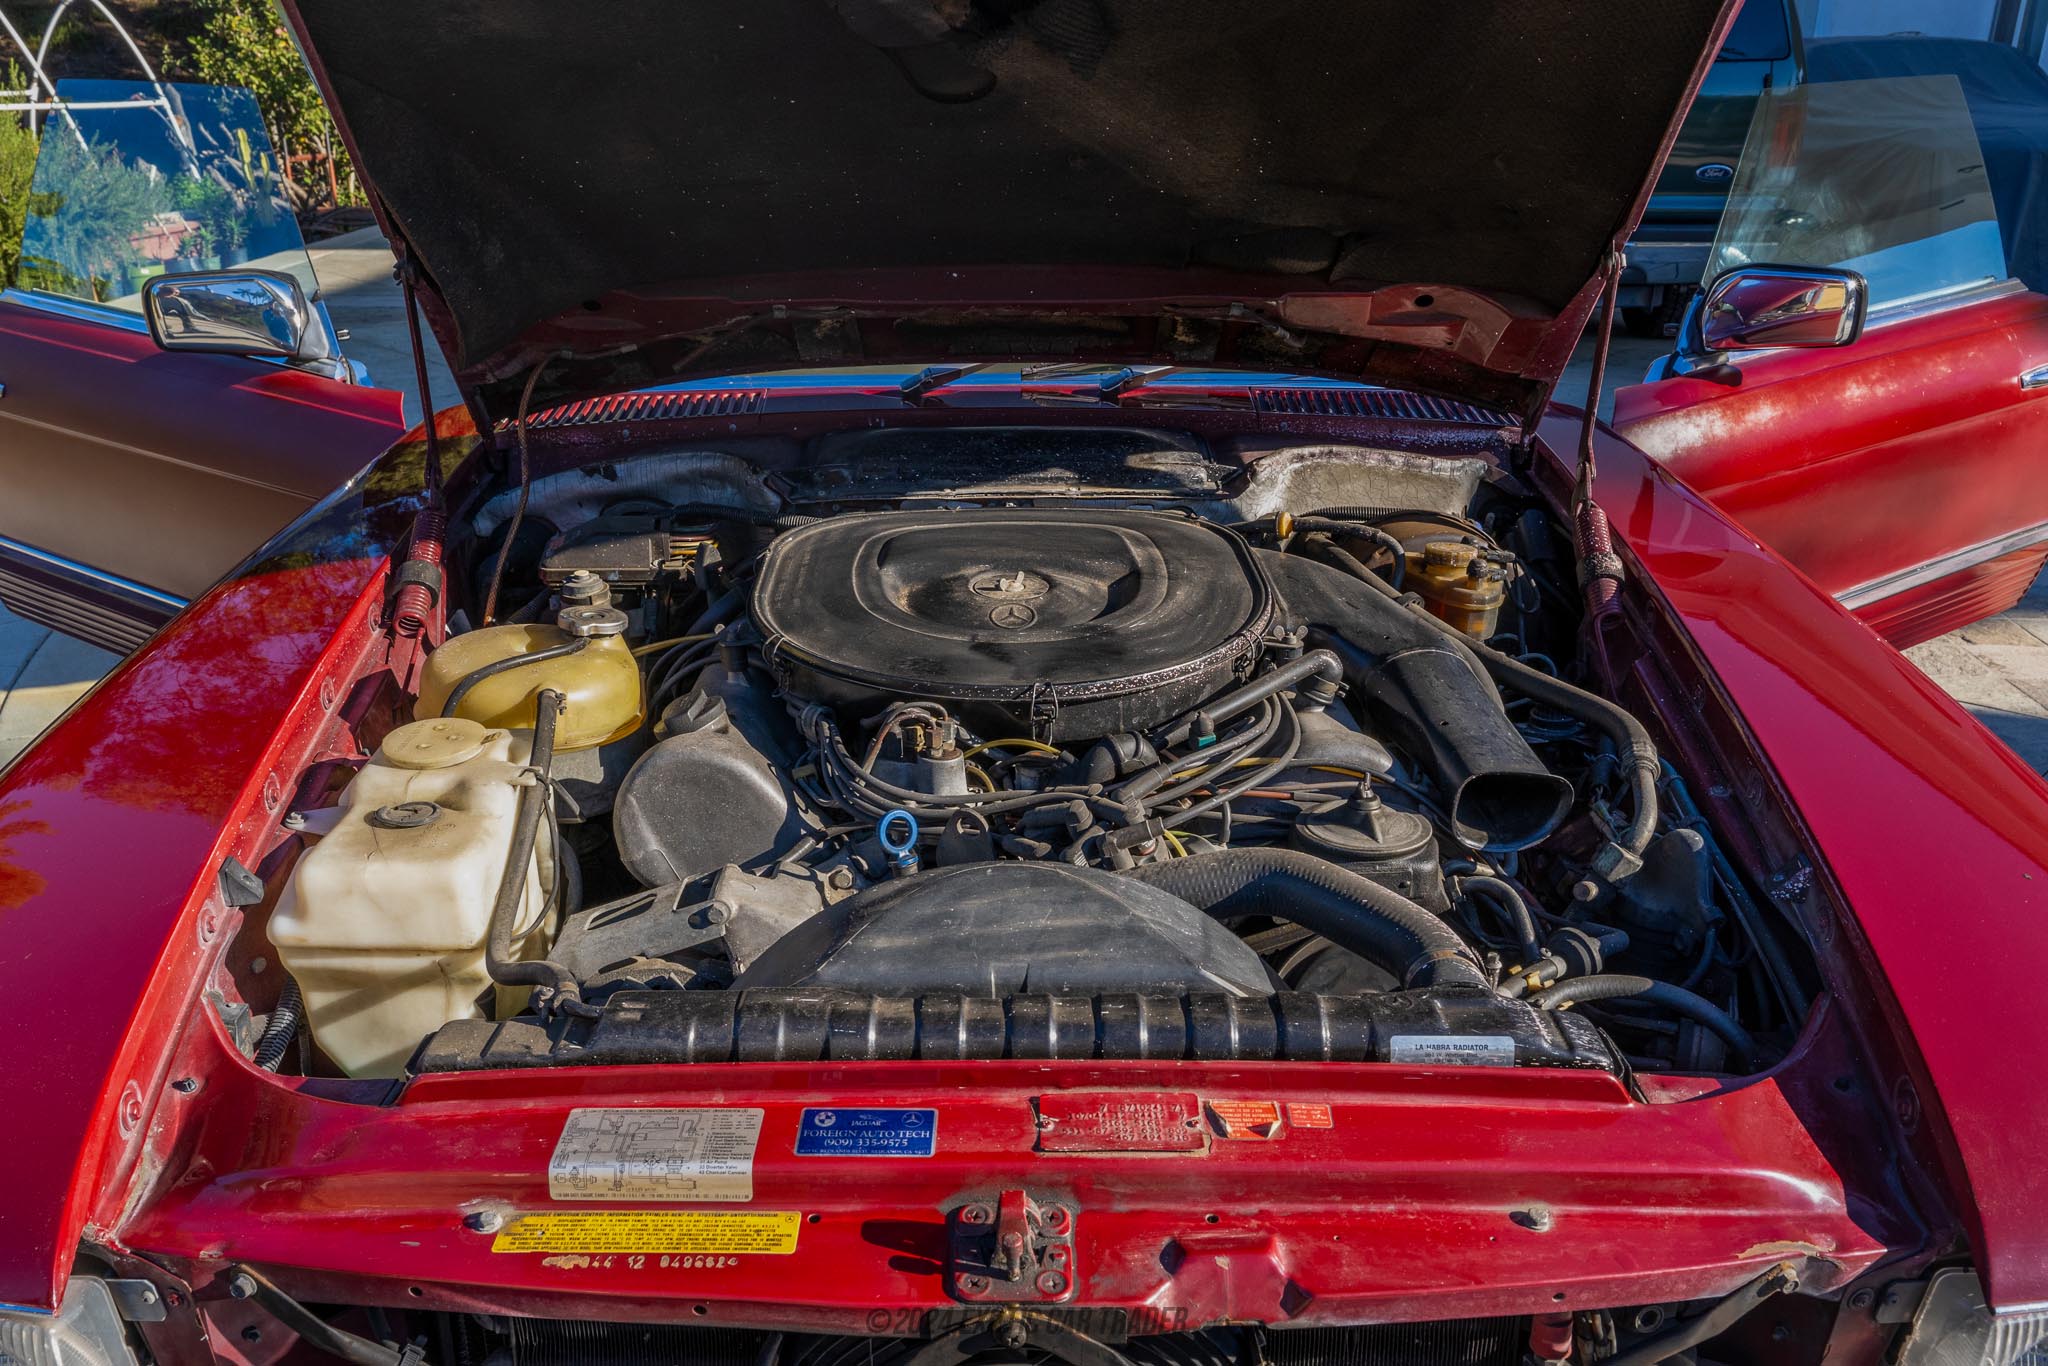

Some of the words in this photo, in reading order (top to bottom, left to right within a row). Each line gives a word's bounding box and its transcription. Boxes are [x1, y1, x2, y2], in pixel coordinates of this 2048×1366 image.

[1704, 168, 1725, 177] Ford
[803, 1129, 857, 1138] FOREIGN
[859, 1130, 895, 1138] AUTO
[898, 1130, 930, 1138] TECH
[824, 1138, 853, 1147] (909)
[857, 1138, 908, 1147] 335-9575
